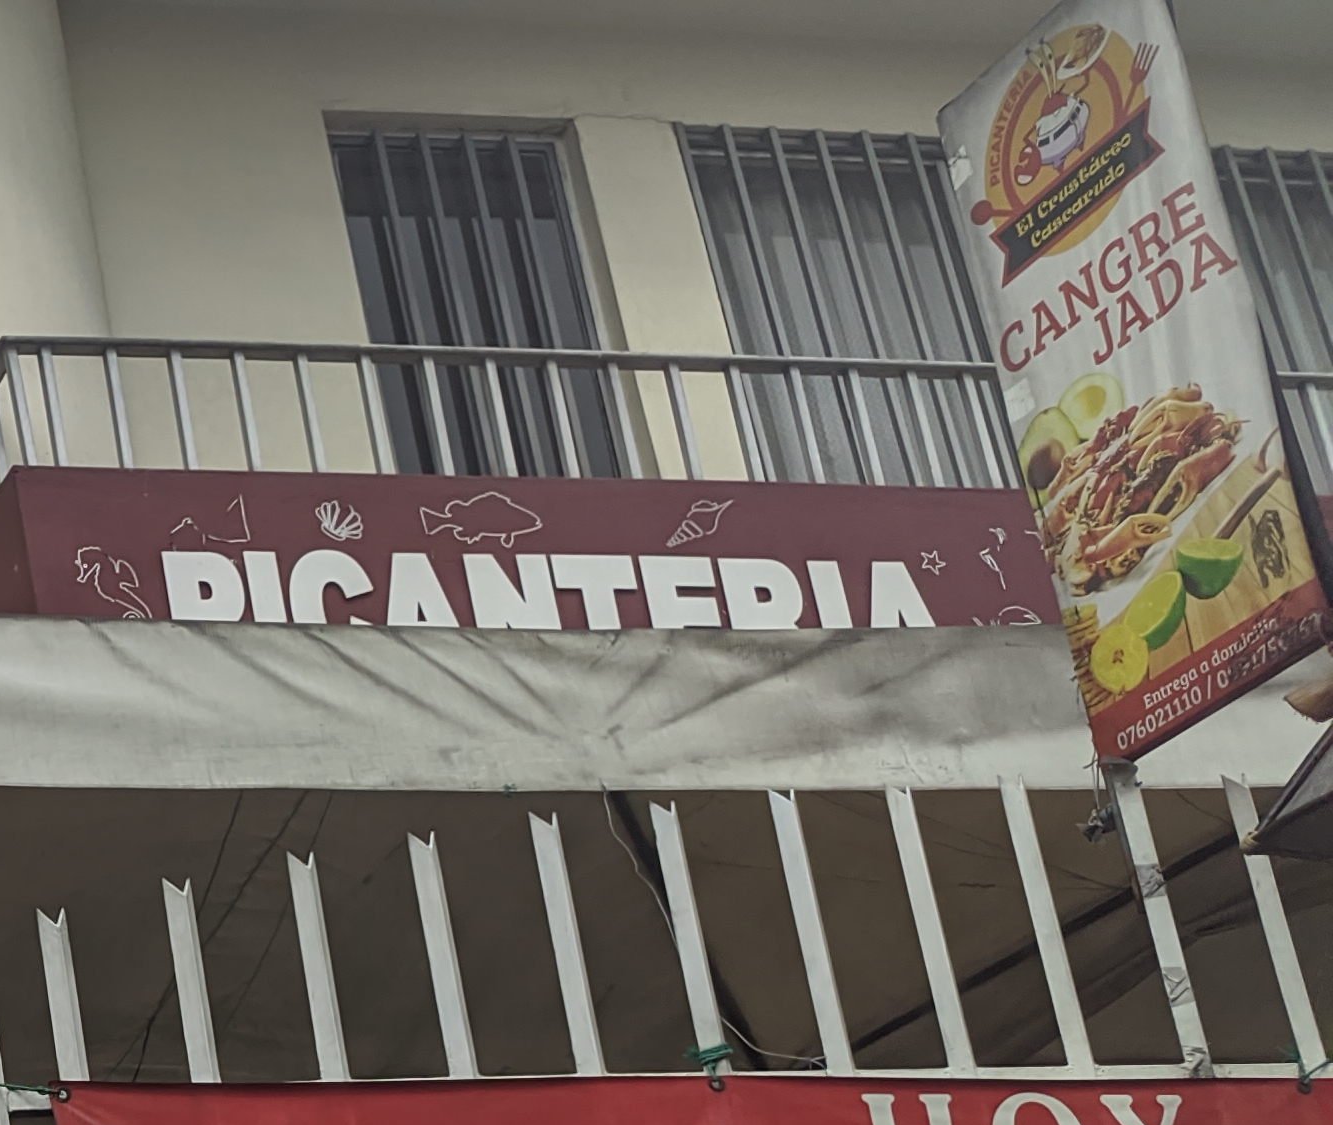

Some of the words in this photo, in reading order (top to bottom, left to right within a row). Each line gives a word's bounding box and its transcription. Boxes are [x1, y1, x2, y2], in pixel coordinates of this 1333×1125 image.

[989, 70, 1032, 187] PICANTERIA
[1014, 212, 1035, 237] El
[1030, 162, 1126, 249] Cascarudo
[1000, 181, 1206, 373] CANGRE
[1093, 232, 1238, 366] JADA
[161, 549, 937, 630] PICANTERIA
[1116, 686, 1202, 750] 076021110
[1142, 666, 1198, 709] Entrega
[1200, 661, 1210, 674] a
